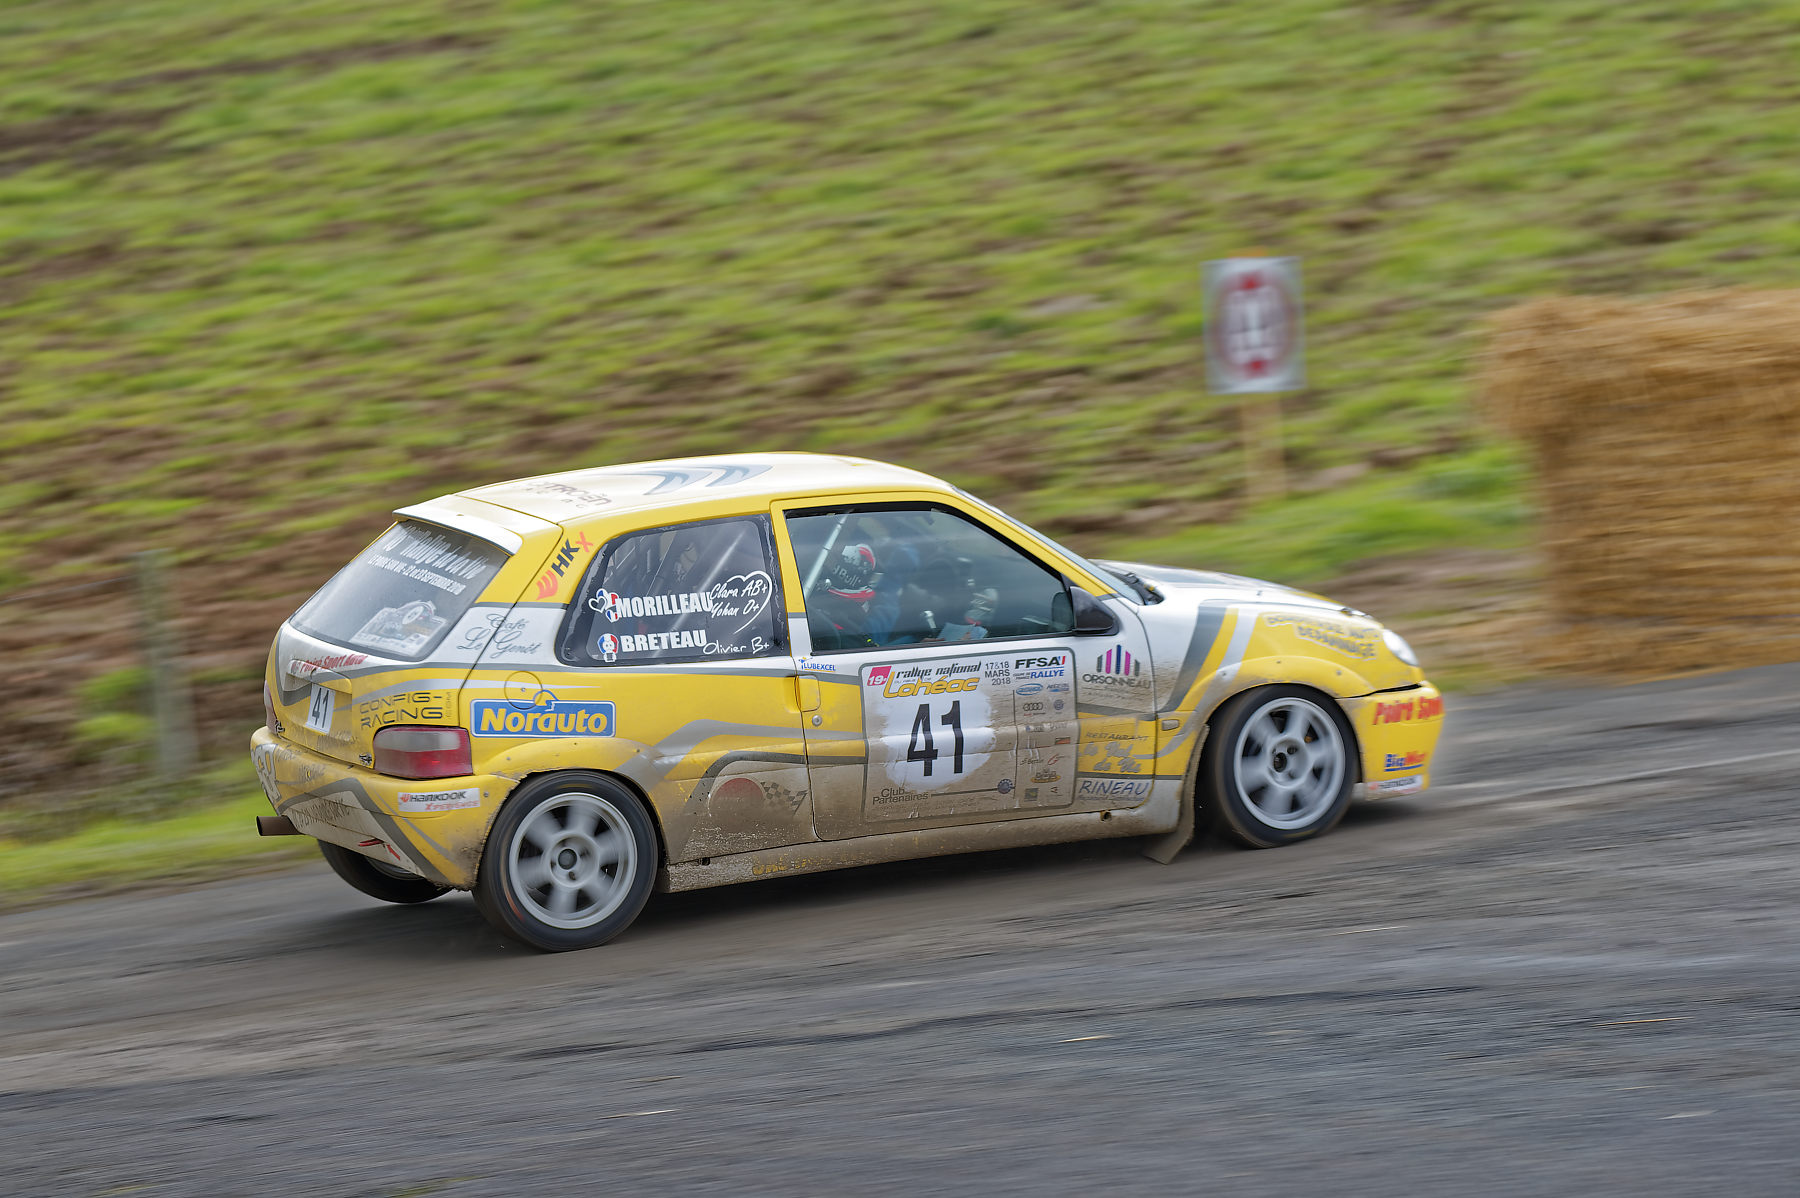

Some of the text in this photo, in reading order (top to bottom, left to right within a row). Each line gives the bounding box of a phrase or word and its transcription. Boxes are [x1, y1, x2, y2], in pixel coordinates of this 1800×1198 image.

[709, 582, 739, 600] Clara
[616, 591, 714, 618] MORILLEAU
[710, 601, 740, 619] Yohan
[486, 613, 530, 631] Café
[456, 626, 492, 651] Le
[620, 629, 707, 653] BRETEAU
[702, 636, 770, 655] Olivier B+
[896, 666, 933, 680] rallye
[936, 660, 982, 678] national
[1015, 656, 1061, 670] FFSA
[984, 669, 1010, 678] MARS
[991, 677, 1012, 686] 2018
[1030, 669, 1065, 679] RALLYE
[883, 671, 981, 698] Lohéac
[311, 687, 331, 729] 41
[360, 706, 444, 731] RACING
[480, 707, 608, 733] Norauto
[907, 700, 965, 776] 41
[880, 786, 906, 799] Club
[1079, 780, 1150, 796] RINEAU
[872, 791, 929, 805] Partenaires
